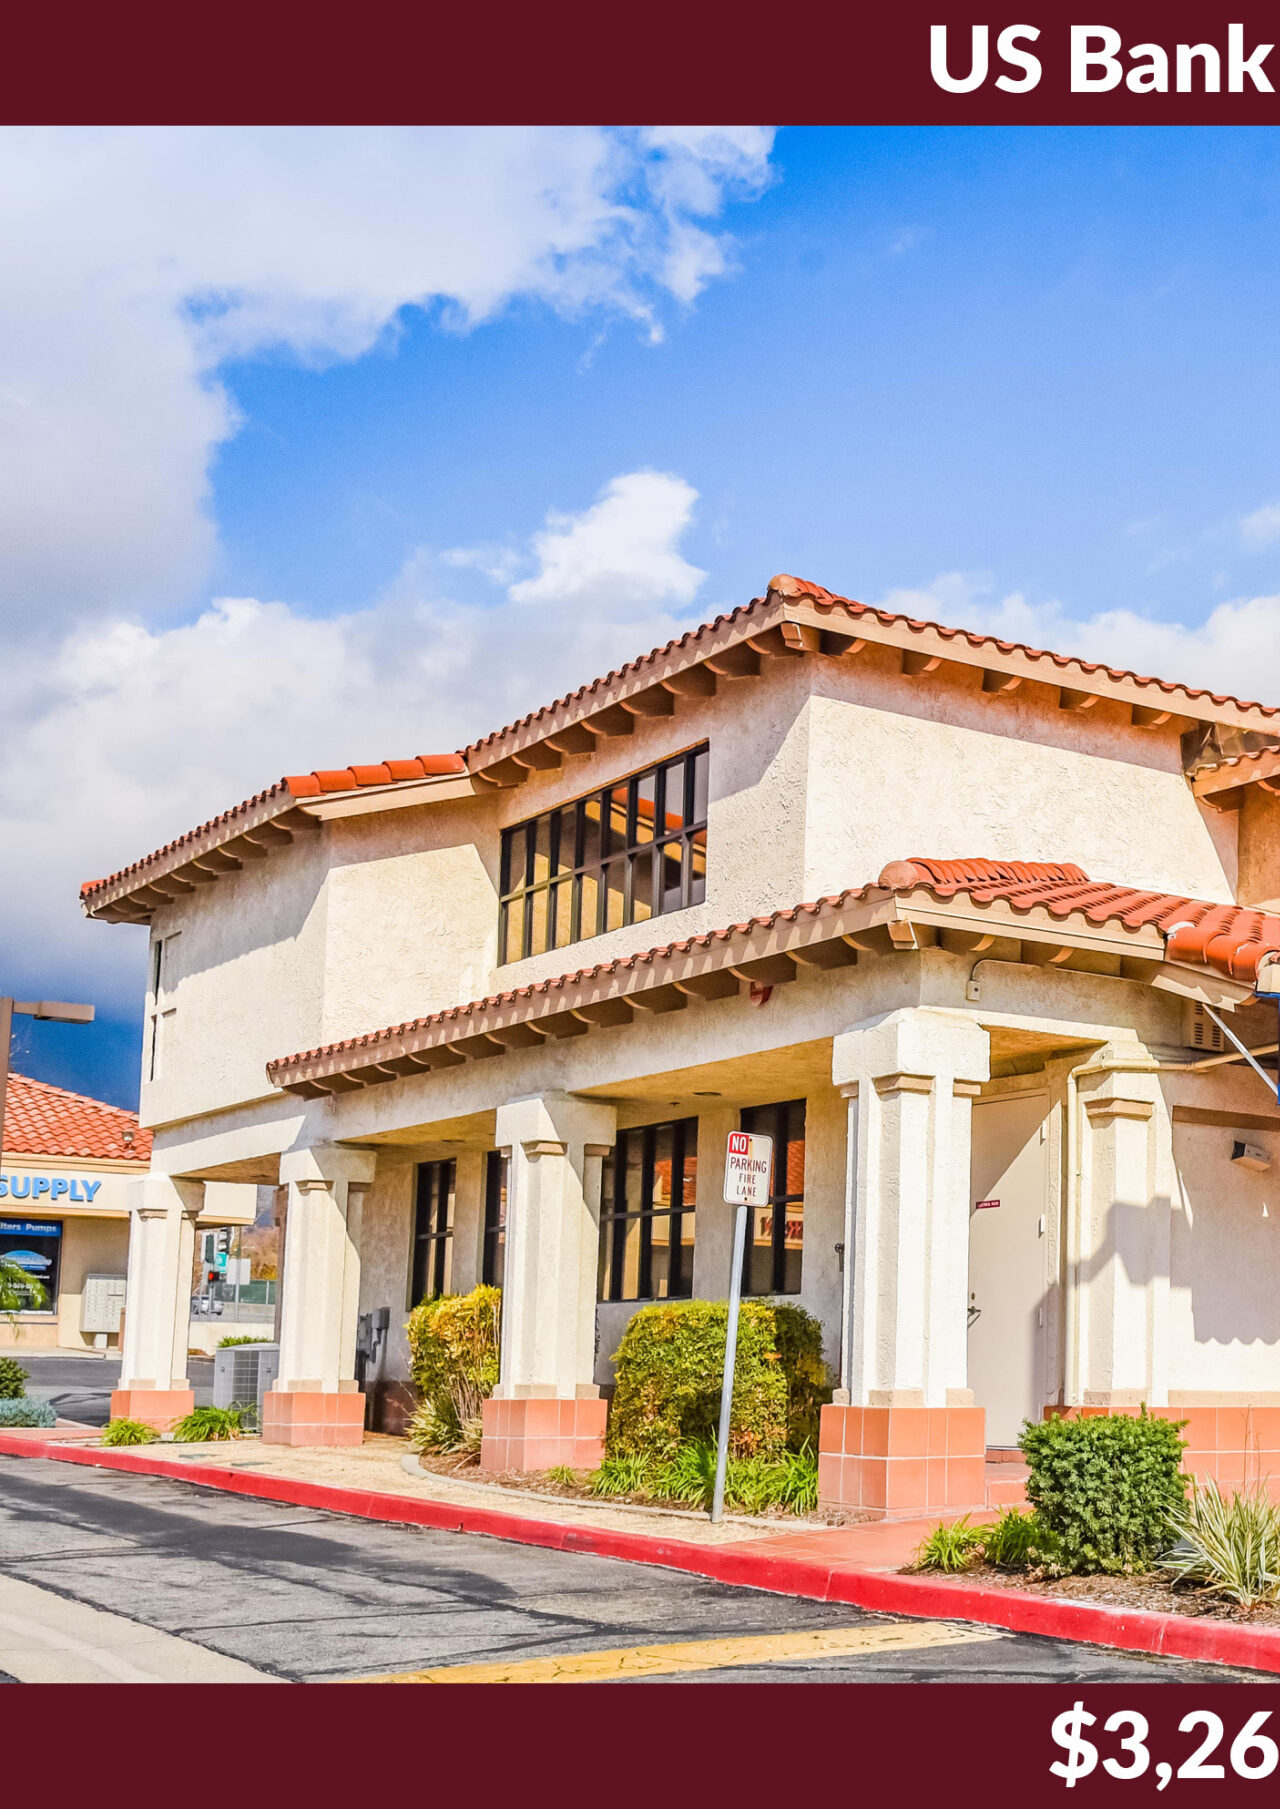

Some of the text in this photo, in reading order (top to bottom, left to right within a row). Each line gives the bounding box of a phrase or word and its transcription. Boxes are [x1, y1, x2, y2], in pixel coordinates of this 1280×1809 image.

[732, 1136, 746, 1152] NO
[730, 1157, 767, 1173] PARKING
[739, 1173, 756, 1184] FIRE
[737, 1186, 756, 1196] LANE
[25, 1223, 56, 1232] Pumps
